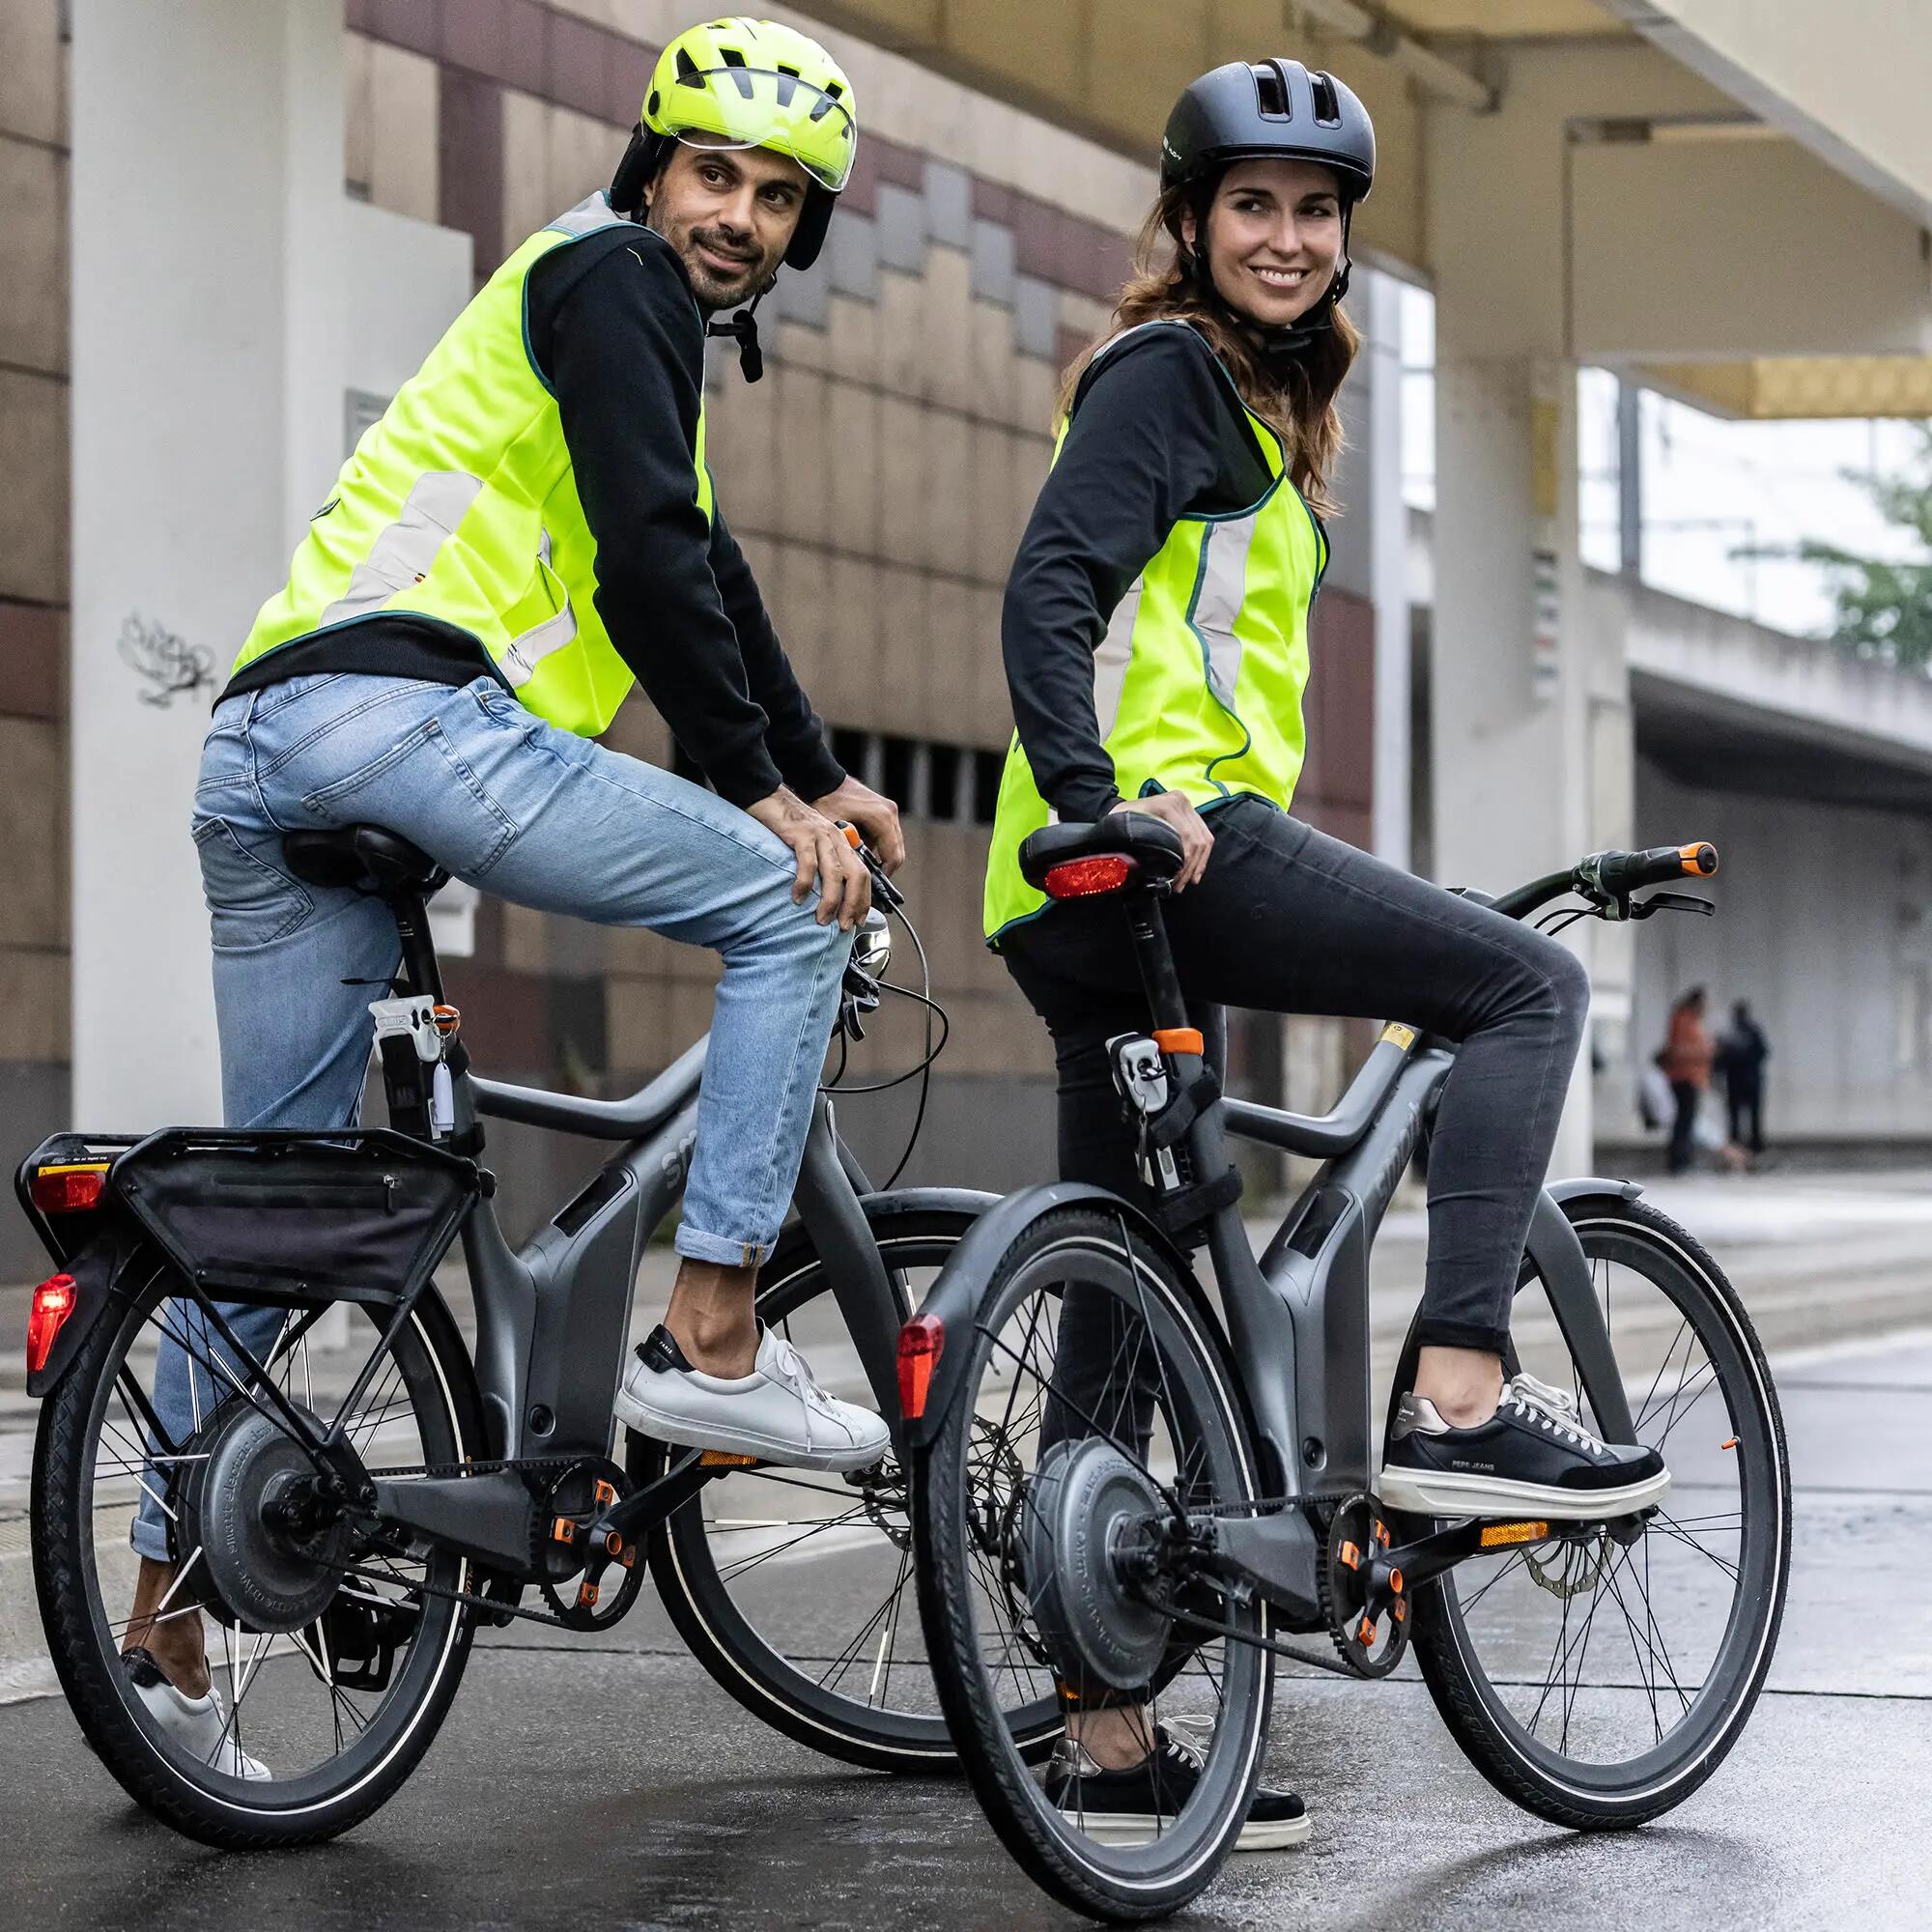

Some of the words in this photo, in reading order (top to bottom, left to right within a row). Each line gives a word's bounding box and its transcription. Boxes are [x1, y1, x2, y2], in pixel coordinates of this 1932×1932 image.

[223, 1442, 255, 1502] electric
[1452, 1460, 1469, 1468] PEPE
[1471, 1462, 1495, 1471] JEANS
